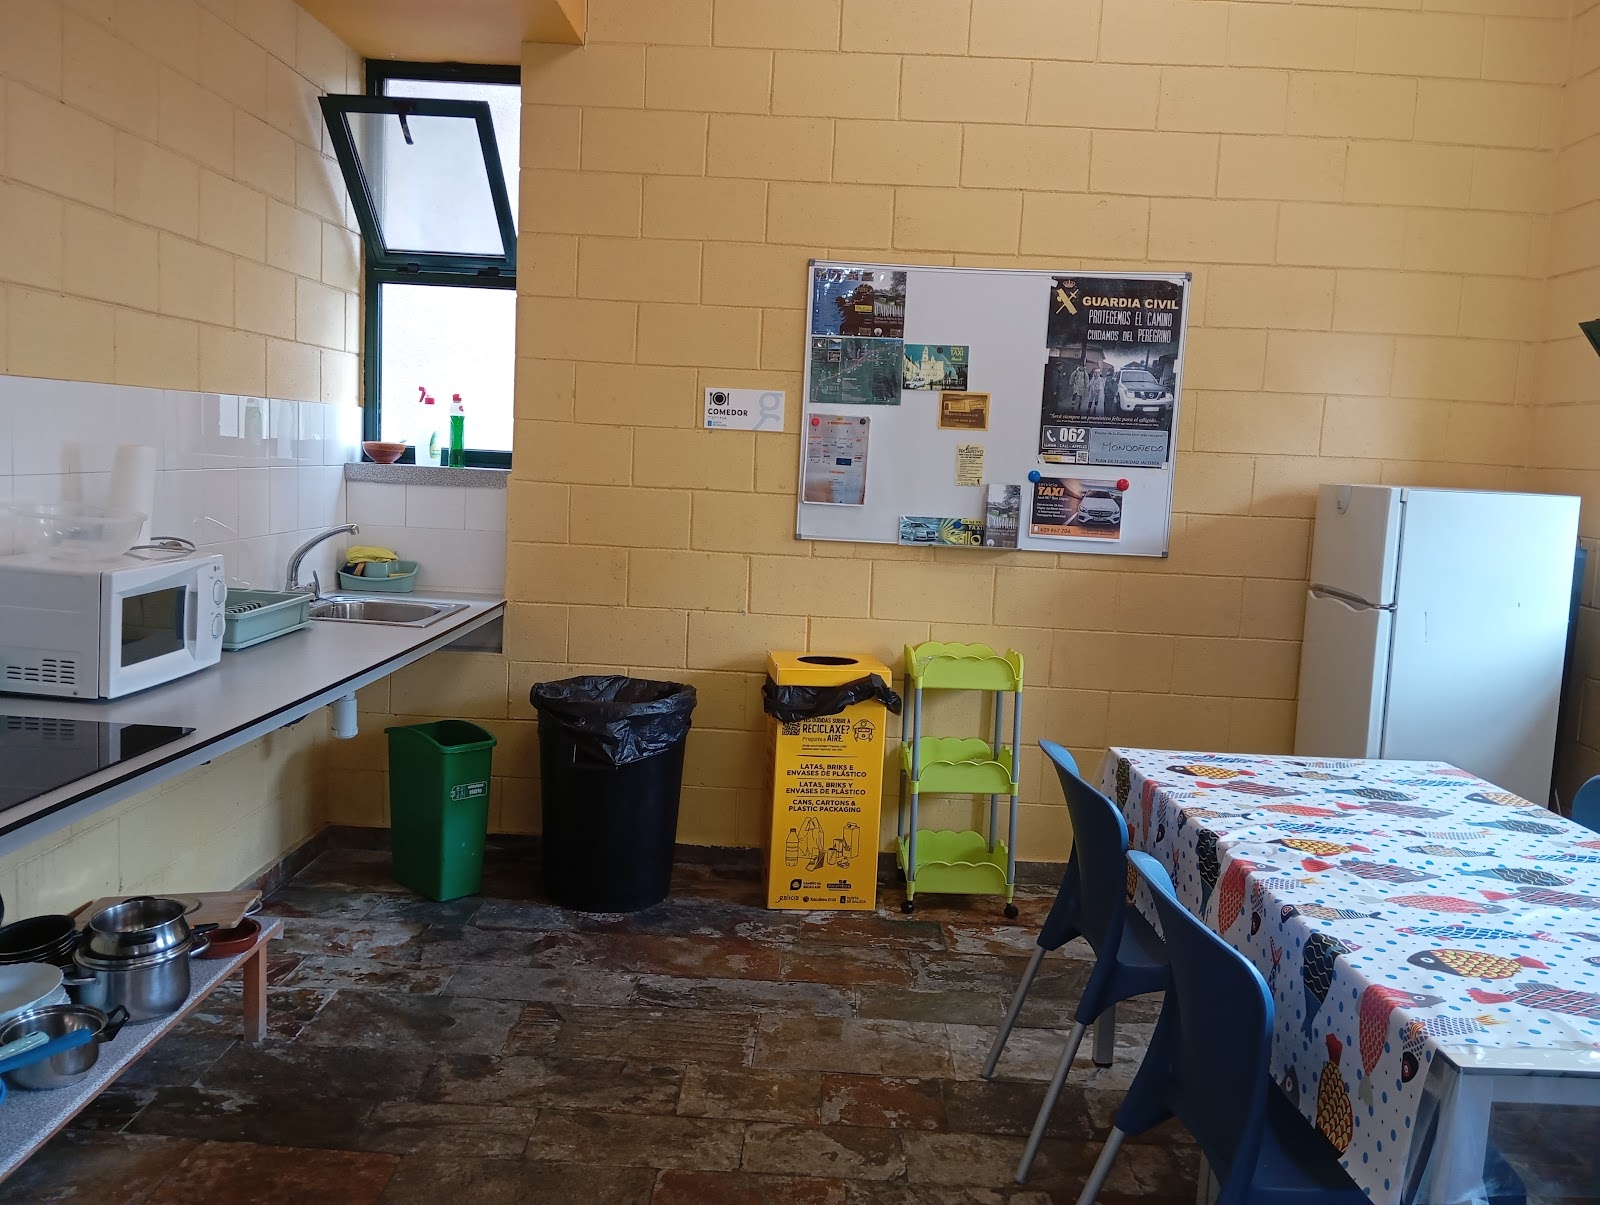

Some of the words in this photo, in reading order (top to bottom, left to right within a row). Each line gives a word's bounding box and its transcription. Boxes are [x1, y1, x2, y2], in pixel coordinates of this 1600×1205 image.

[1082, 297, 1141, 308] GUARDIA
[1144, 299, 1179, 310] CIVIL
[1088, 310, 1131, 325] PROTEGEMOS
[1135, 311, 1142, 326] EL
[1147, 312, 1173, 327] CAMINO
[1087, 330, 1119, 341] CUIDAMOS
[1122, 331, 1133, 342] DEL
[1137, 329, 1171, 343] PEREGRINO
[708, 408, 748, 416] COMEDOR
[1060, 428, 1085, 442] 062
[1101, 442, 1164, 452] MONDOÑEDO
[1037, 486, 1065, 497] TAXI
[802, 724, 851, 734] RECICLAXE?
